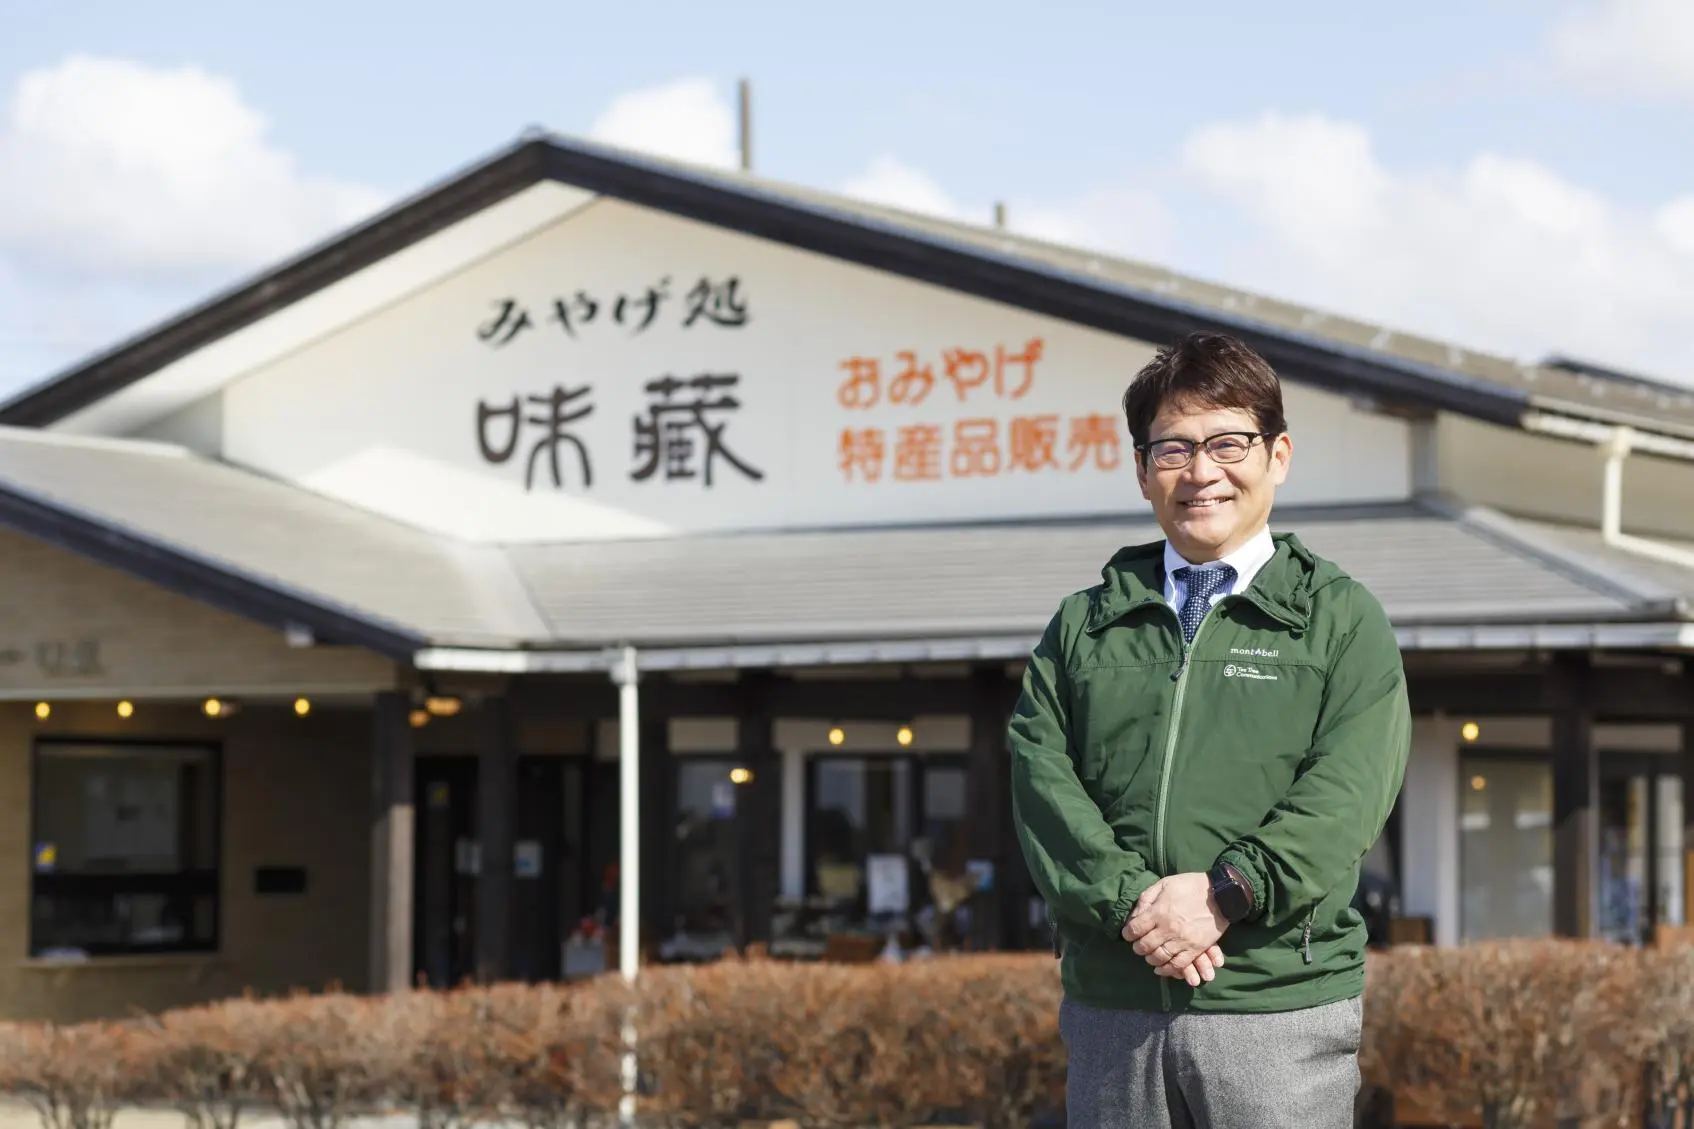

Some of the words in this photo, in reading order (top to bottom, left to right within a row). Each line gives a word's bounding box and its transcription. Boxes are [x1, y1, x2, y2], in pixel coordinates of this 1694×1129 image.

[476, 275, 750, 350] みやげ処
[836, 336, 1044, 410] おみやげ
[838, 410, 1121, 484] 特産品販売
